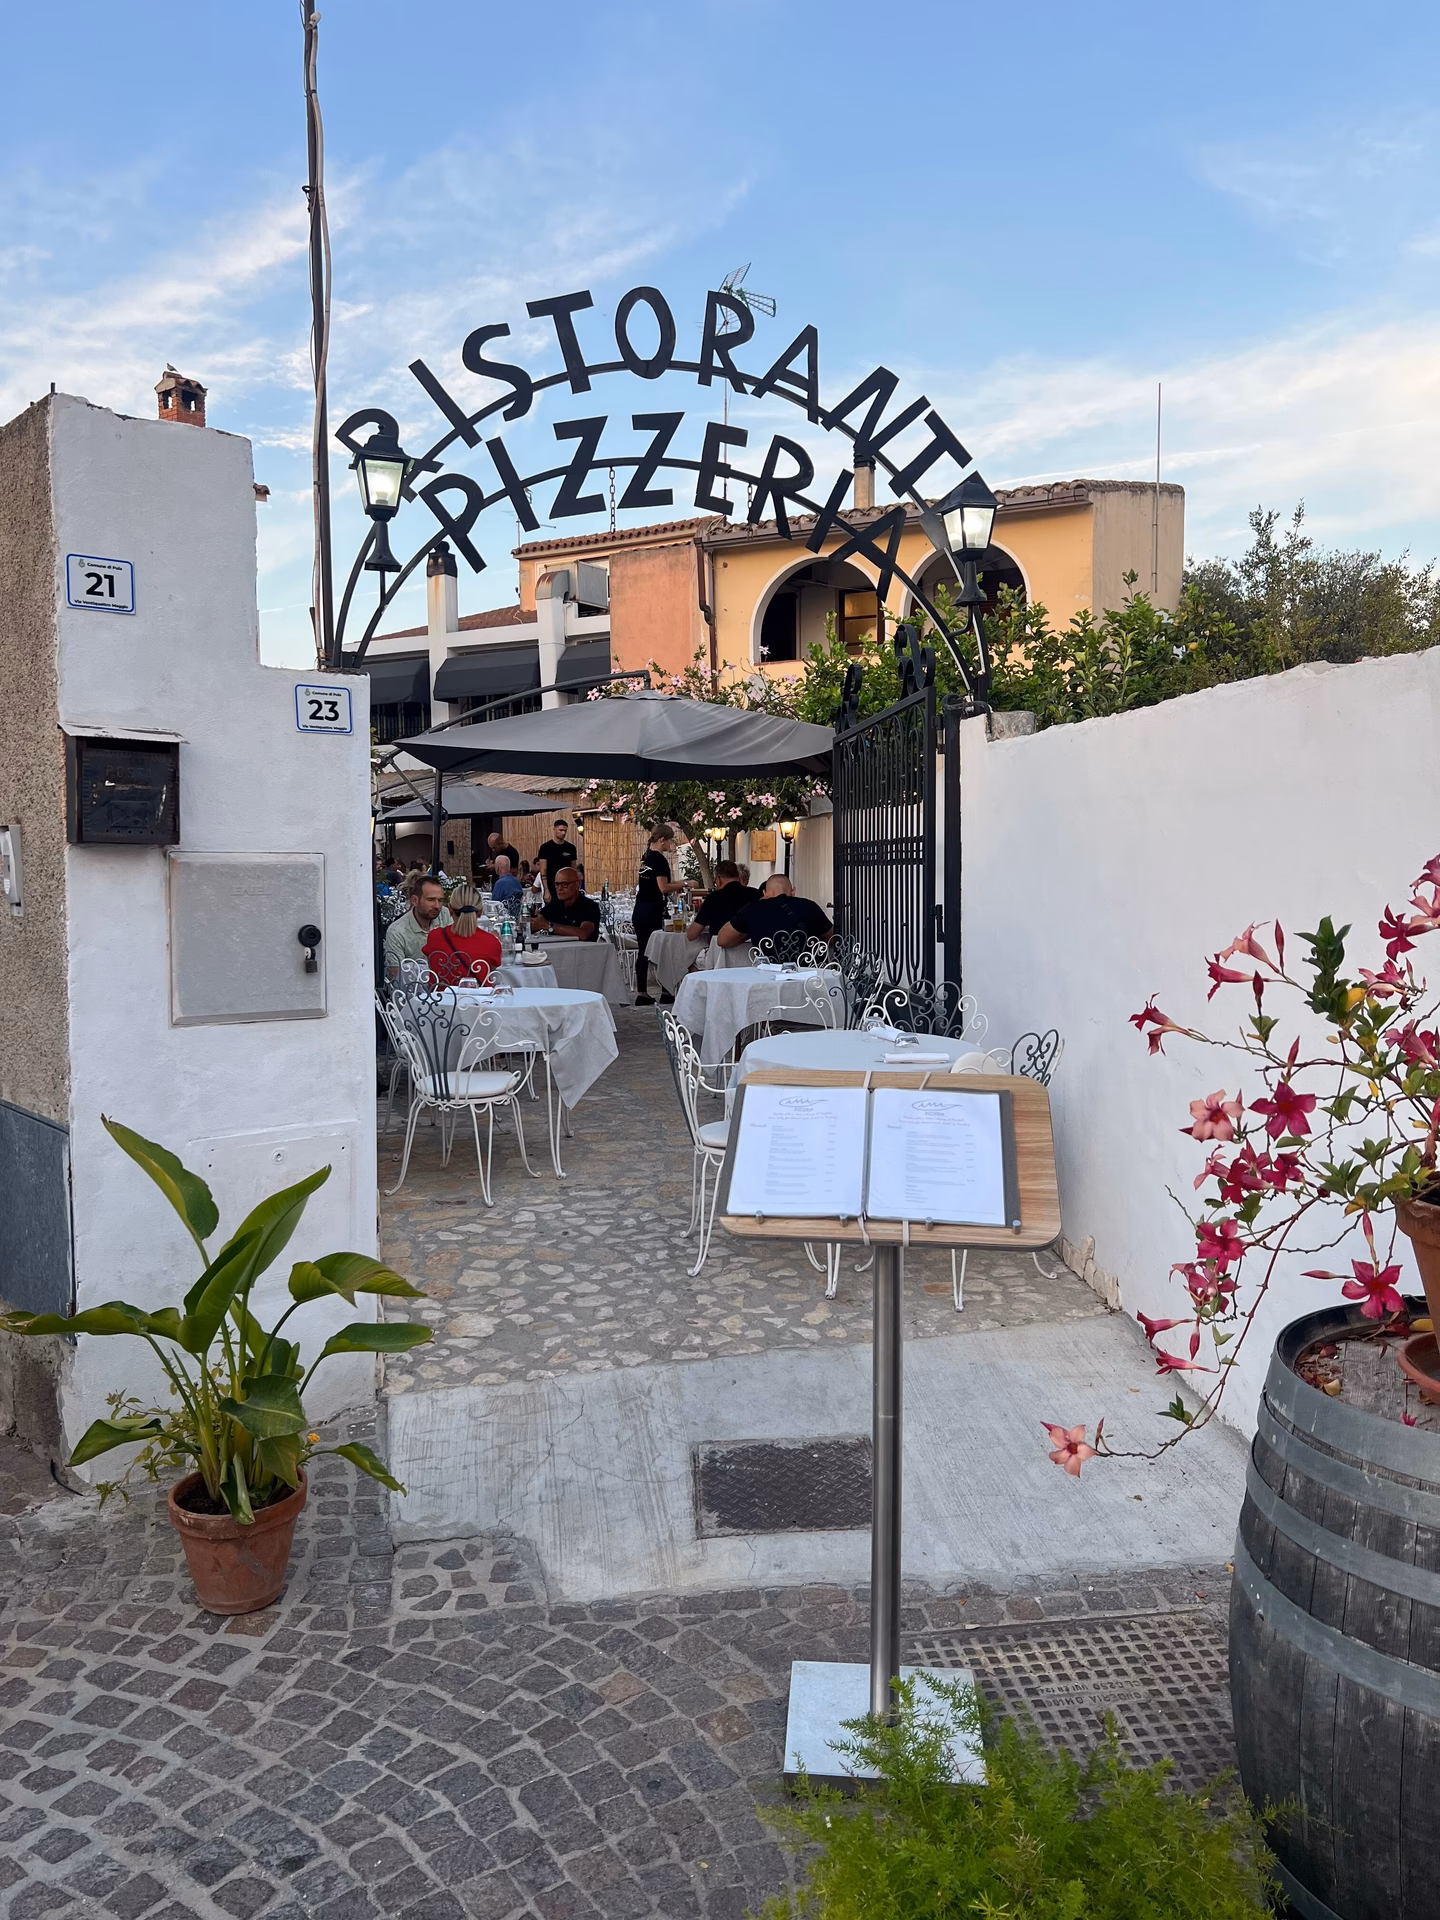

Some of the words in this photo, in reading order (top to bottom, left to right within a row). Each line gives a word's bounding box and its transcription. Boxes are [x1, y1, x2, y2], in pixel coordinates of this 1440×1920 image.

[418, 412, 907, 603] PIZZERIA
[84, 572, 115, 598] 21
[307, 699, 340, 722] 23
